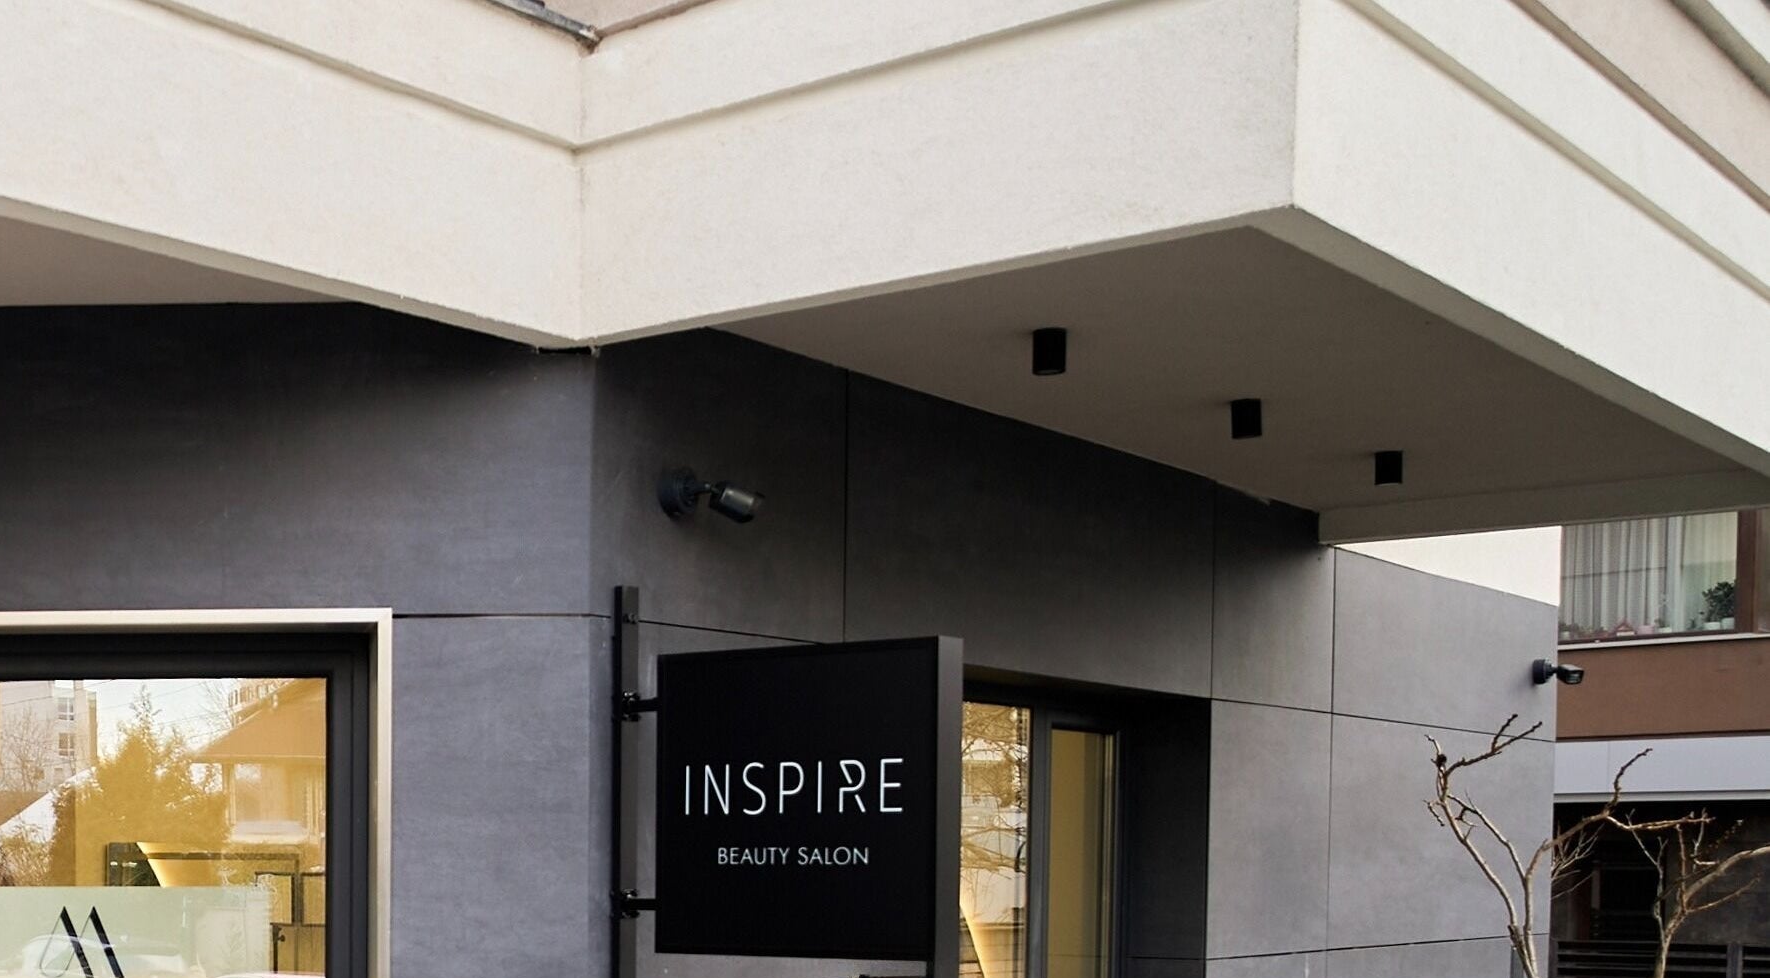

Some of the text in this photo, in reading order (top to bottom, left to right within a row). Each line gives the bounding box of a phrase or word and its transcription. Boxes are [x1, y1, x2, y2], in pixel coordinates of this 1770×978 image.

[685, 757, 904, 816] INSPIRE
[717, 846, 870, 866] BEAUTY SALON
